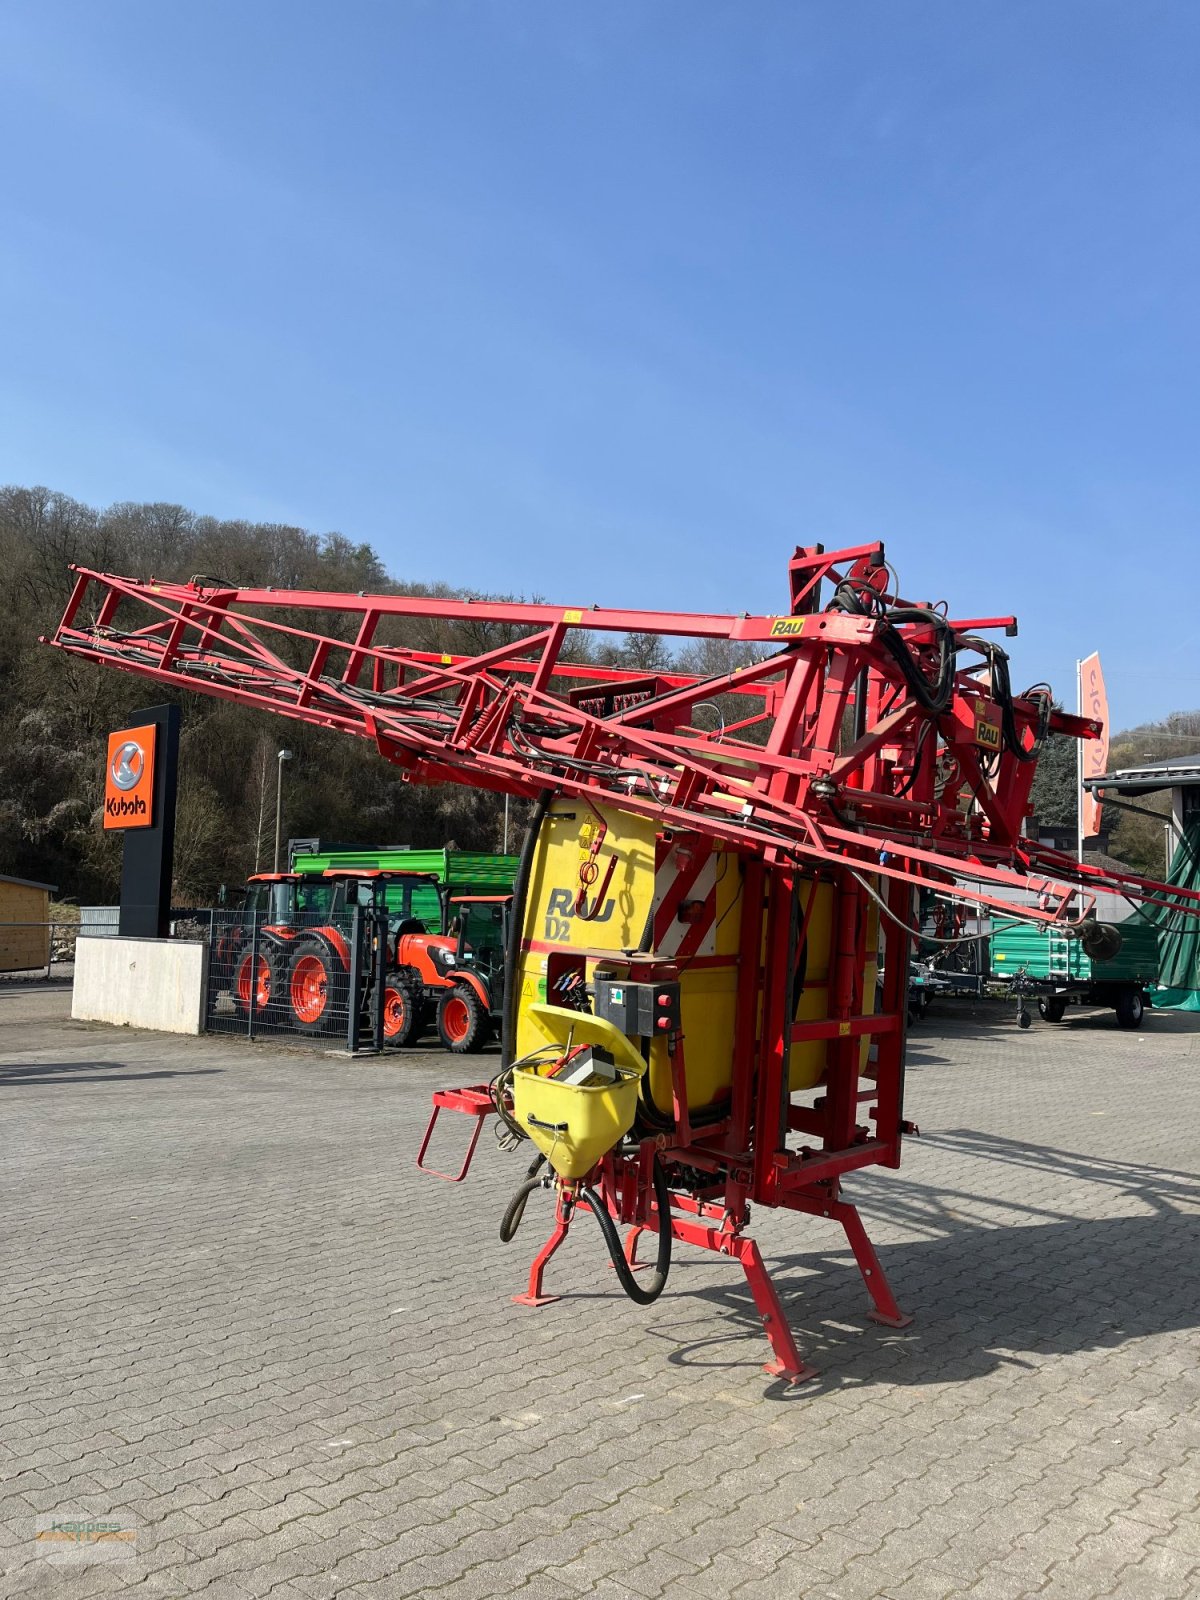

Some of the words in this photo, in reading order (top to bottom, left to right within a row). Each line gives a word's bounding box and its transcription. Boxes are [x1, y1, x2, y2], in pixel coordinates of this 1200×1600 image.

[771, 621, 804, 636] RAU
[978, 721, 999, 745] RAU
[106, 794, 147, 817] Kubota
[546, 887, 616, 922] RAU
[543, 916, 571, 941] D2
